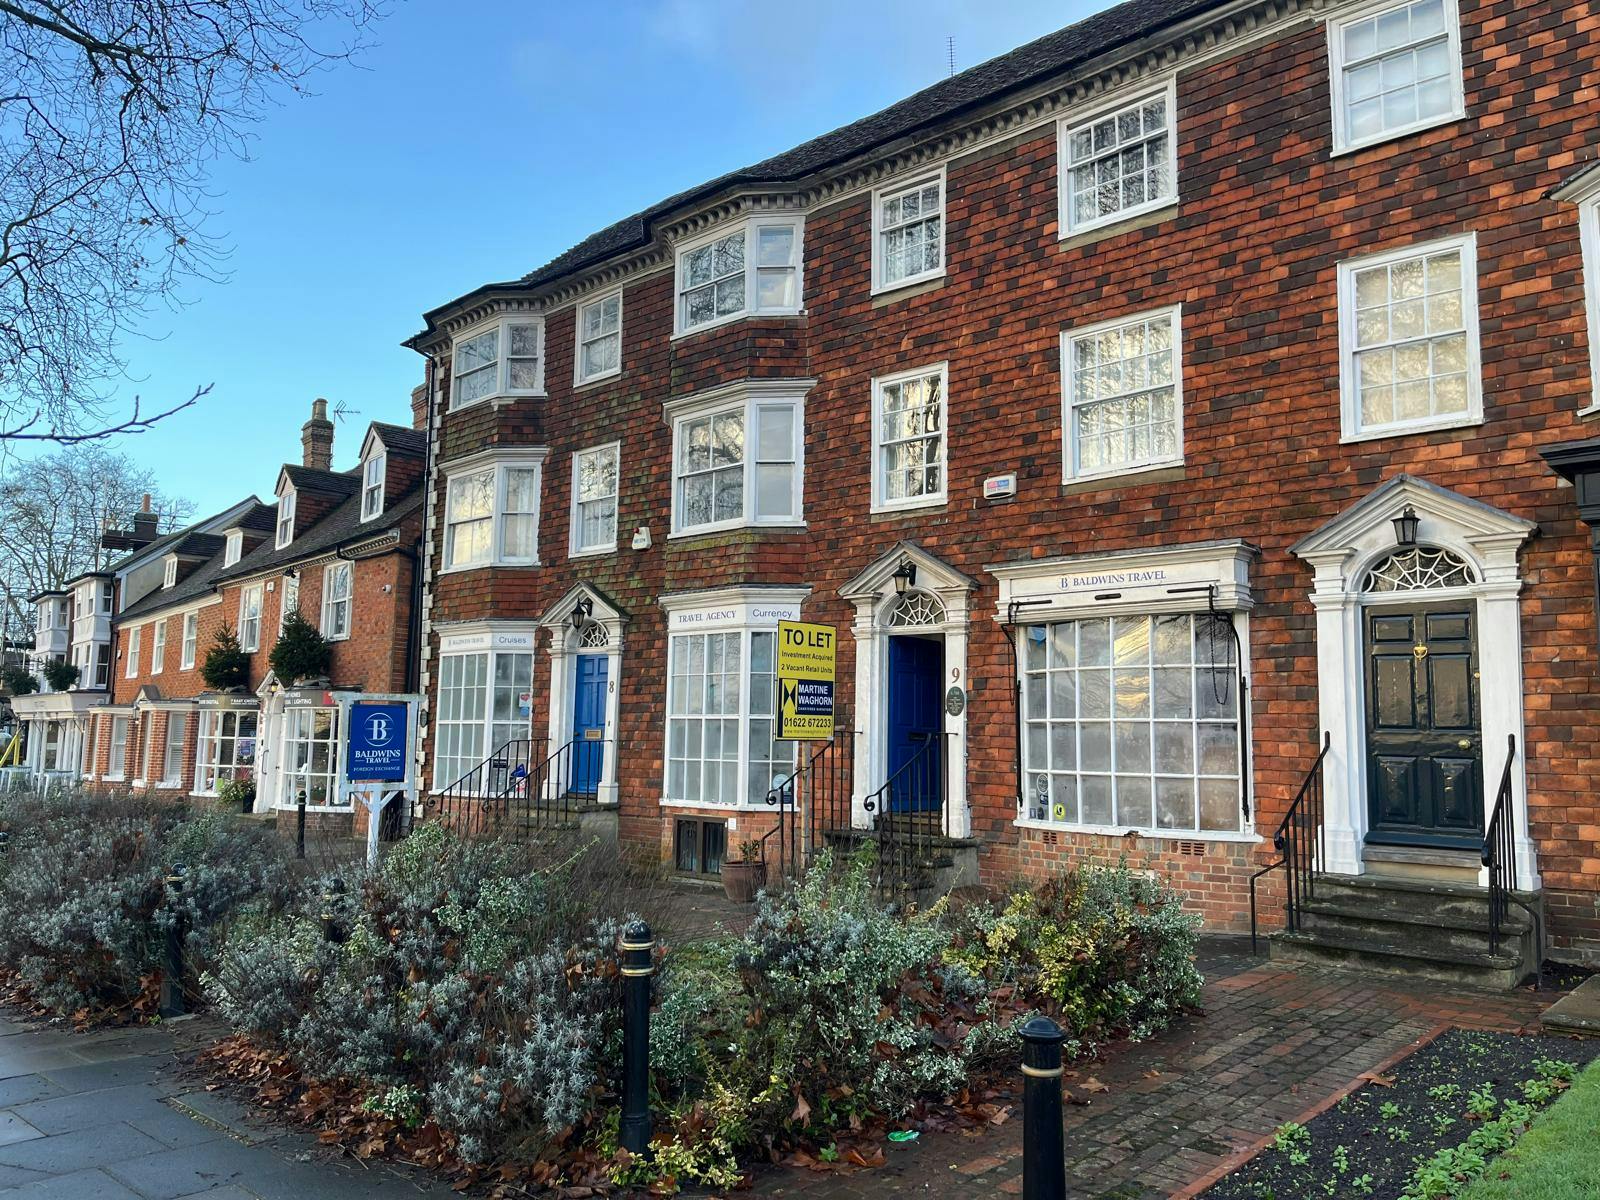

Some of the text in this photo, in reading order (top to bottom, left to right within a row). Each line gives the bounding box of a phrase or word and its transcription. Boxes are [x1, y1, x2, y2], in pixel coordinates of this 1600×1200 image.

[1073, 574, 1125, 586] BALDWINS
[1126, 570, 1167, 582] TRAVEL
[678, 610, 737, 623] TRAVEL AGENCY
[752, 608, 793, 619] Currency
[498, 636, 527, 644] Cruises
[784, 628, 832, 648] TO LET
[781, 650, 833, 662] Investment Acquired
[786, 664, 804, 672] Vacant
[805, 665, 820, 673] Retail
[821, 666, 833, 674] Units
[951, 667, 961, 684] 9
[609, 680, 615, 693] 8
[798, 684, 829, 695] MARTINE
[798, 695, 833, 705] WAGHORN
[784, 718, 832, 728] 01622 672233
[372, 719, 387, 740] B
[355, 749, 401, 758] BALDWINS
